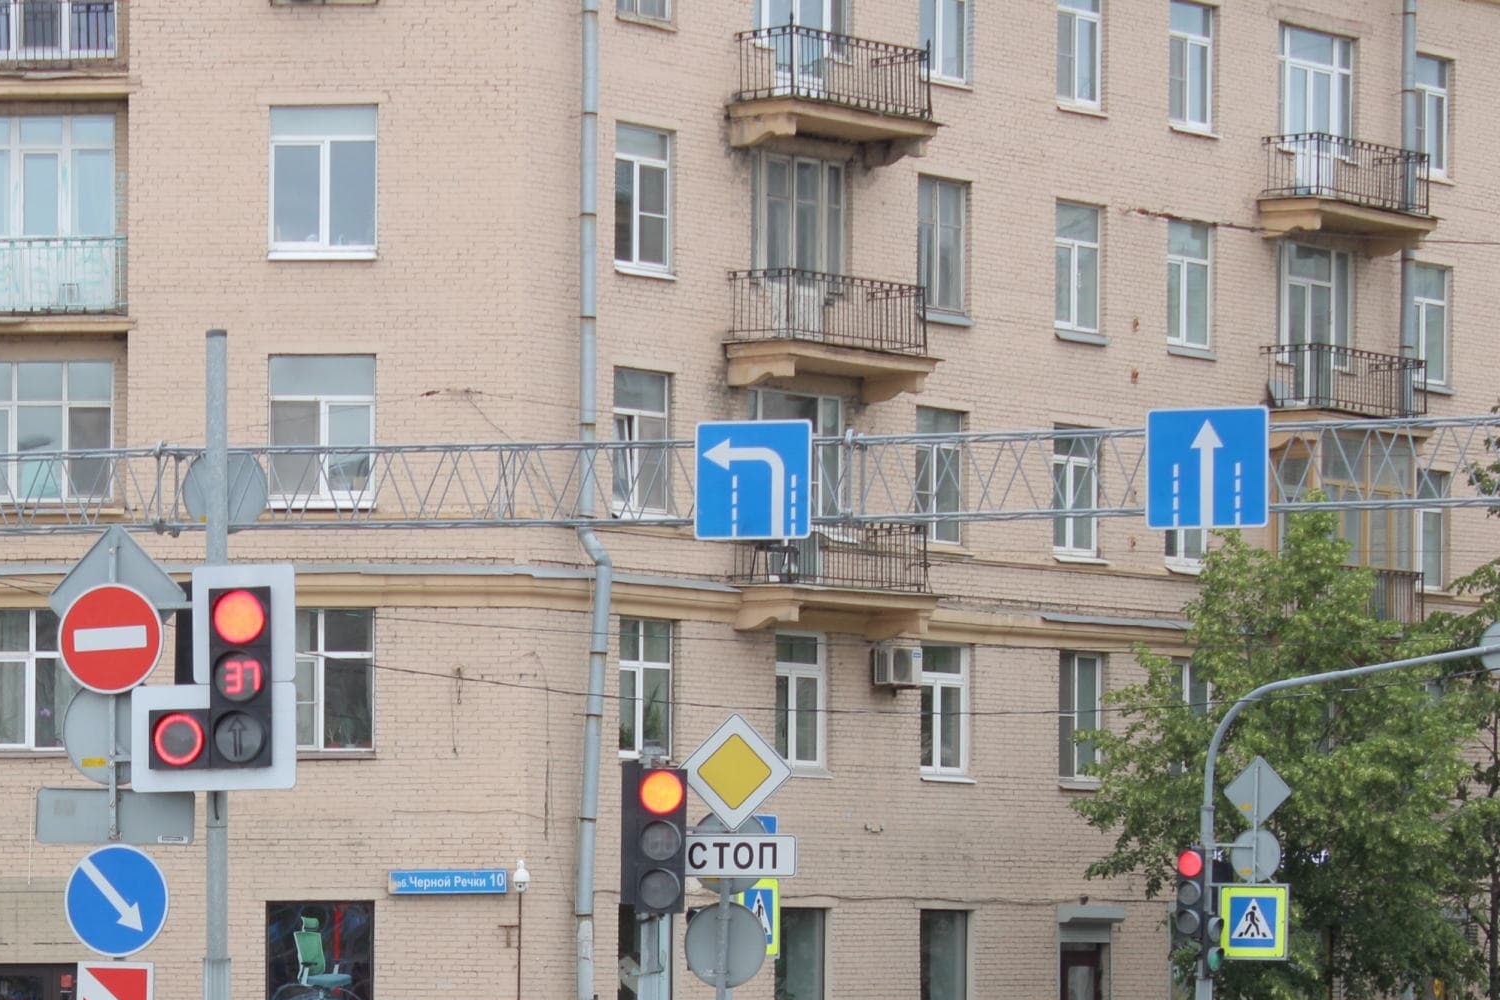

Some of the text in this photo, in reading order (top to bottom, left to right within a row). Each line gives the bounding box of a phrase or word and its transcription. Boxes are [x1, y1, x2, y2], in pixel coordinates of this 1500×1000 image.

[224, 659, 262, 694] 37
[688, 842, 778, 870] СТОП
[409, 874, 451, 890] Черной
[454, 875, 486, 888] Речки
[489, 873, 505, 887] 10
